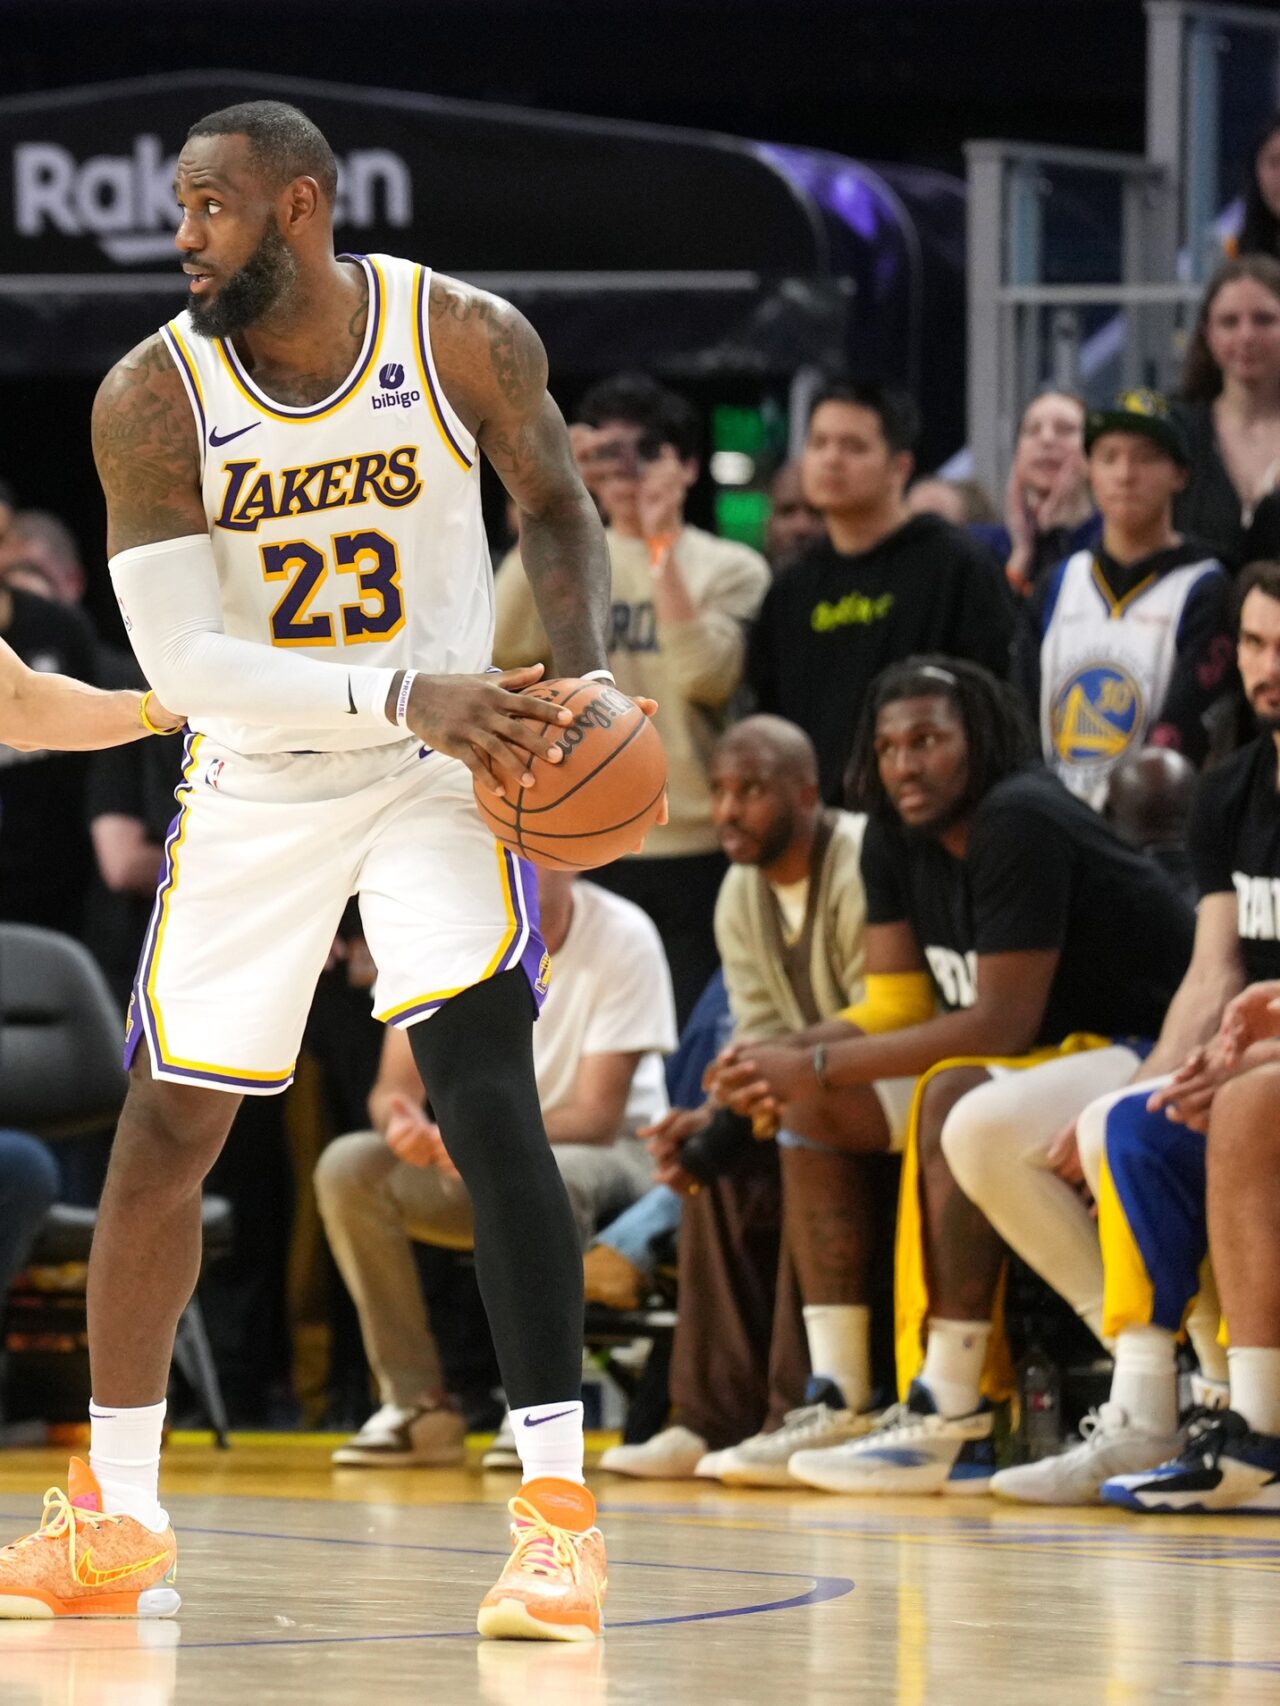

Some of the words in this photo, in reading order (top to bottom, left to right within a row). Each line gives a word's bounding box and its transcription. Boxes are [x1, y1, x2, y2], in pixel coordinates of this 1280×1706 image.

[14, 135, 412, 238] Rakn
[371, 389, 420, 411] bibigo
[214, 444, 424, 533] LAKERS
[258, 527, 406, 648] 23
[398, 680, 411, 718] PROMISE
